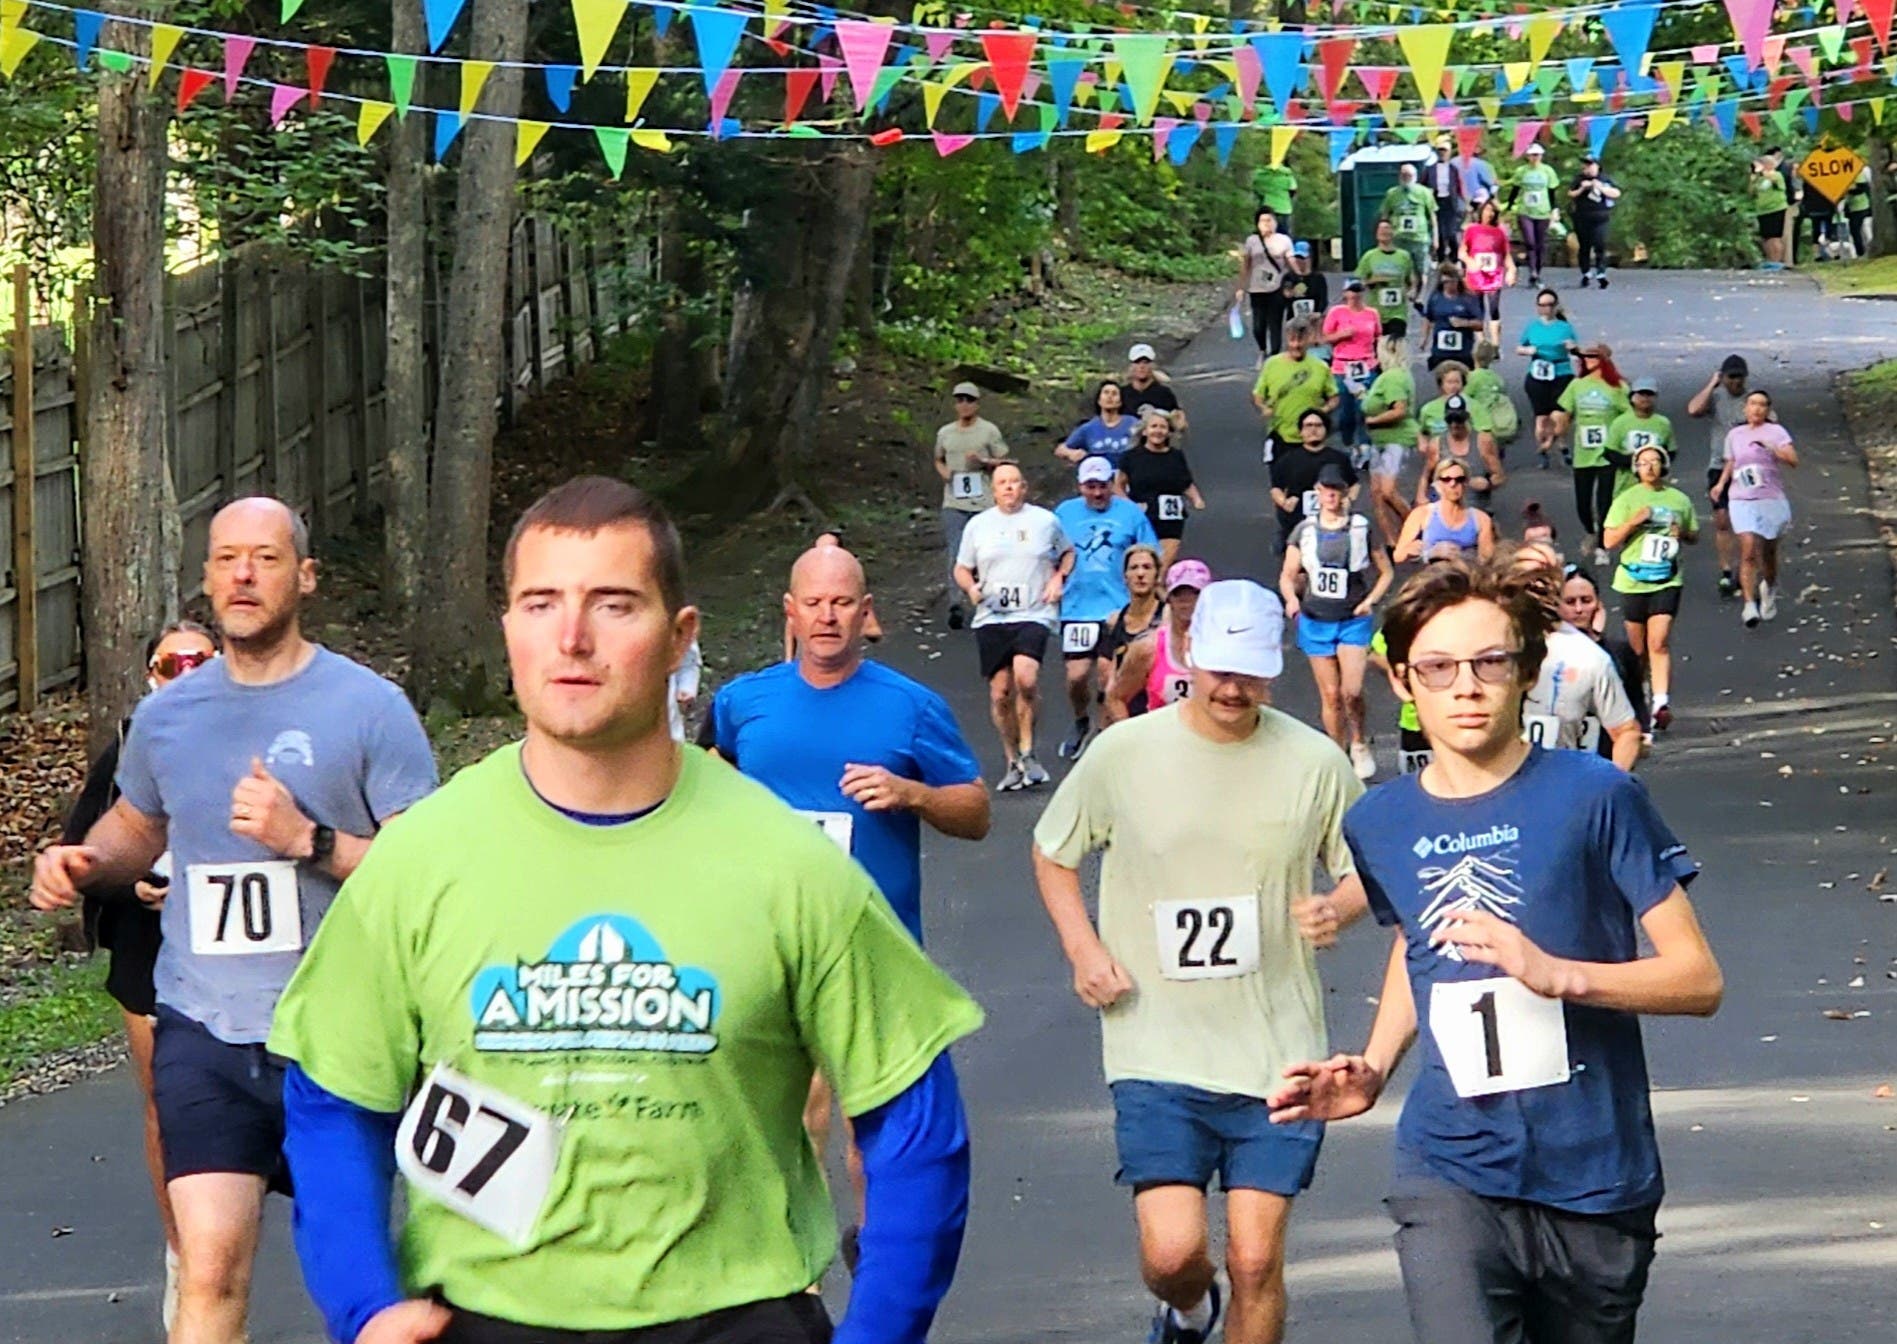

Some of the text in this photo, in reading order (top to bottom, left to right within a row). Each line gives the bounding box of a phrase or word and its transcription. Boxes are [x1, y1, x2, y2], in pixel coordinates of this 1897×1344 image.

[1808, 158, 1853, 177] SLOW
[962, 475, 972, 494] 8
[1652, 538, 1671, 560] 18
[999, 586, 1020, 608] 34
[1317, 571, 1339, 593] 36
[1069, 626, 1091, 648] 40
[1433, 823, 1520, 855] Columbia
[206, 872, 272, 942] 70
[1176, 906, 1237, 967] 22
[517, 958, 678, 990] MILES FOR
[479, 982, 713, 1031] A MISSION
[1470, 991, 1503, 1078] 1
[412, 1082, 531, 1197] 67
